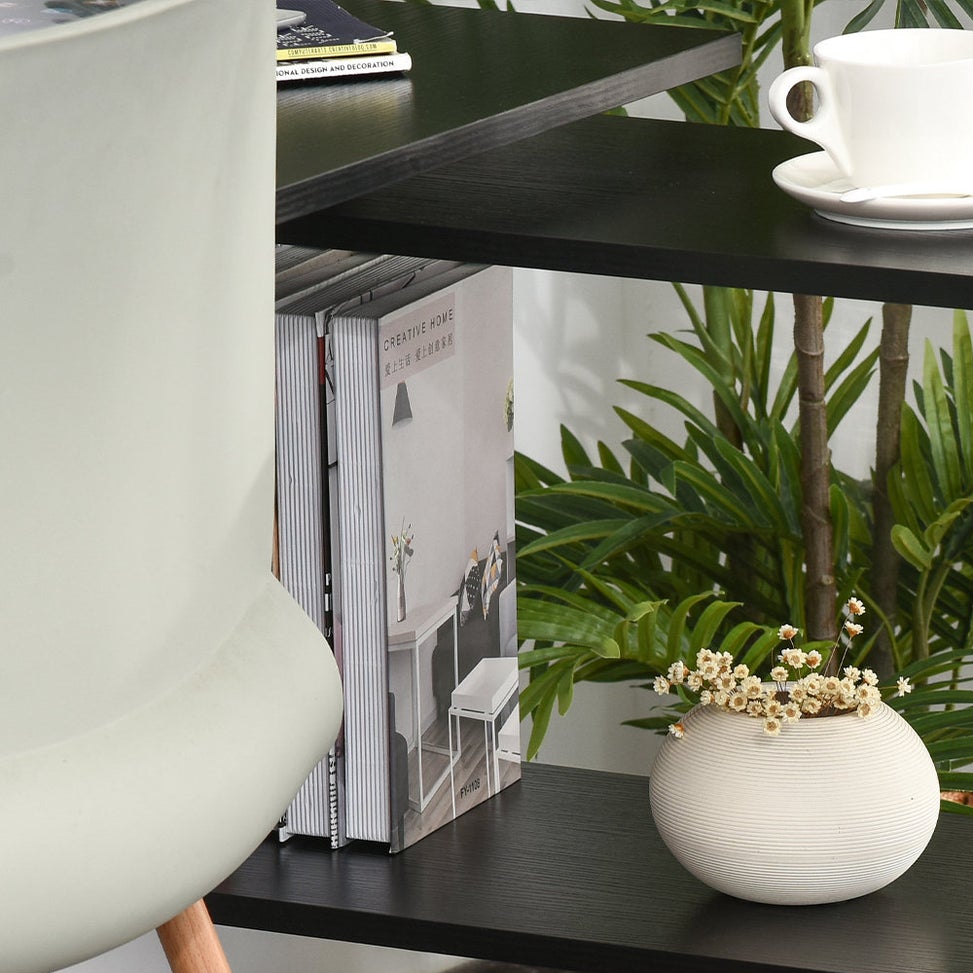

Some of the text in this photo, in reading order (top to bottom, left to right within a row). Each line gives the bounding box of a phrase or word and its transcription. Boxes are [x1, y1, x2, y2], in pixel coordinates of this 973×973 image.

[301, 66, 328, 75] DESIGN
[330, 64, 346, 72] AND
[347, 60, 394, 71] DECORATION
[384, 308, 453, 352] CREATIVE HOME
